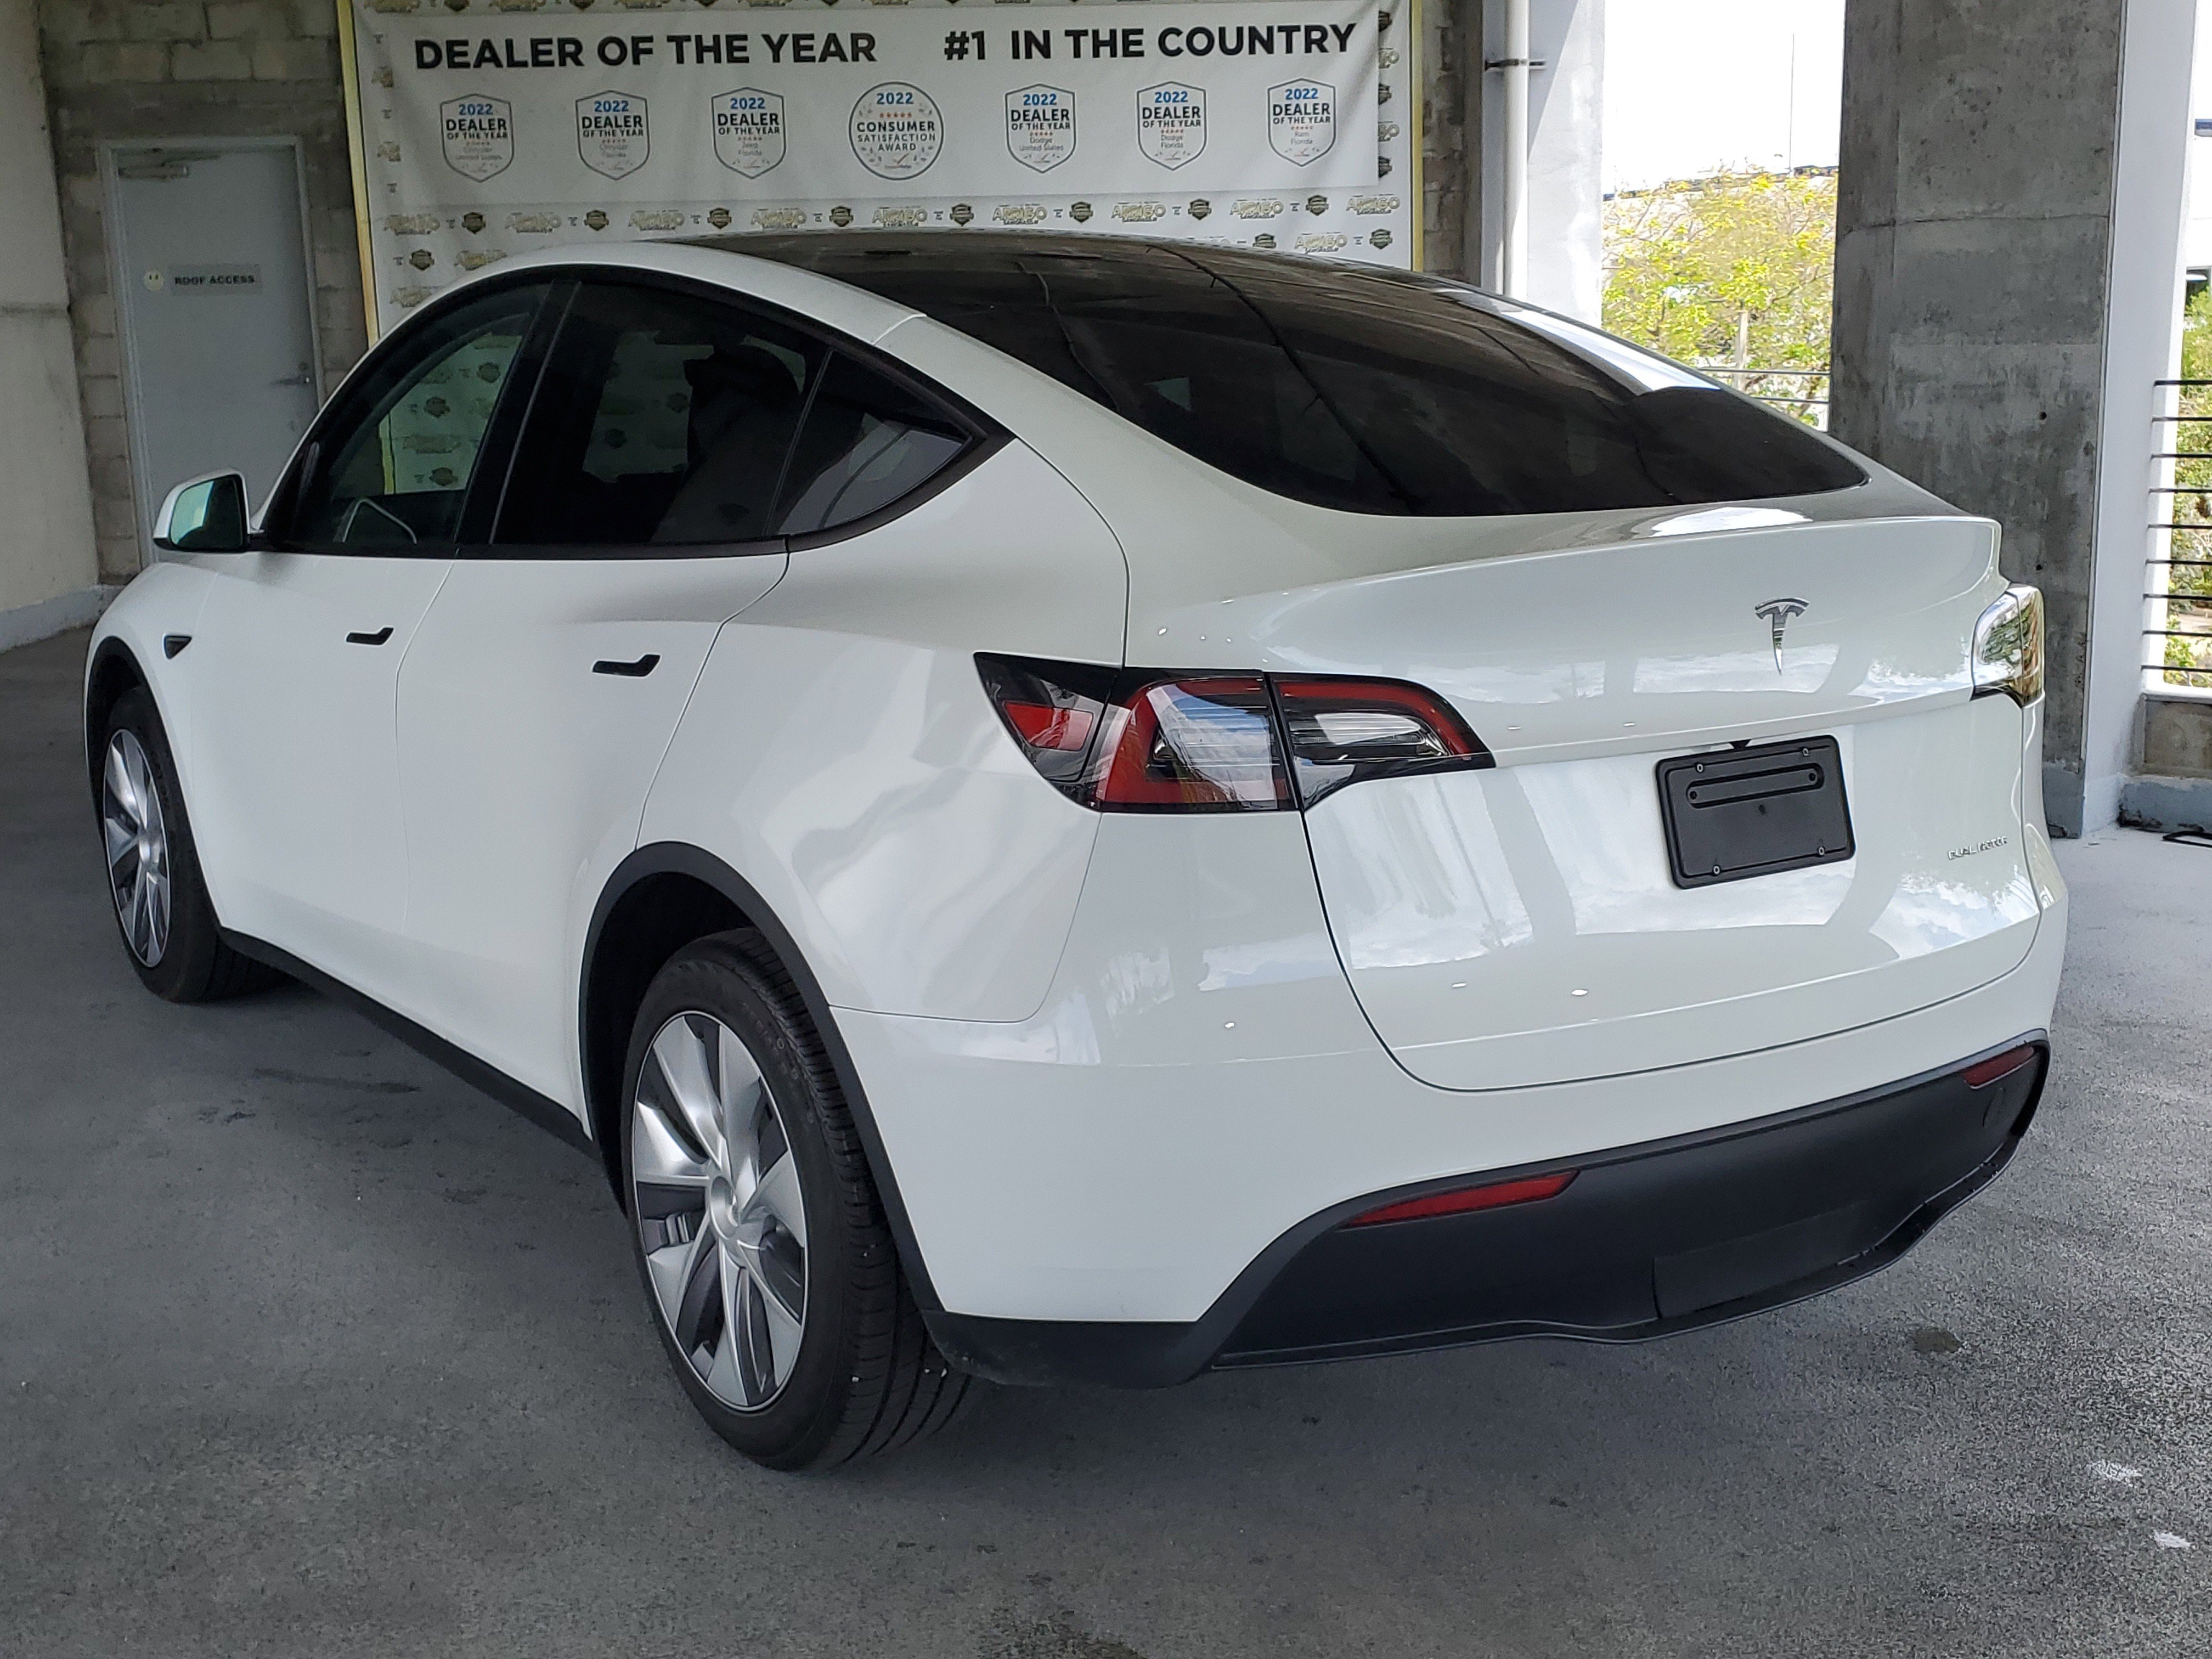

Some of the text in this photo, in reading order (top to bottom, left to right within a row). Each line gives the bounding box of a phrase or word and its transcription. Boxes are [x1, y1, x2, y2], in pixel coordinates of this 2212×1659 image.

[944, 22, 1357, 61] #1 IN THE COUNTRY
[415, 33, 877, 69] DEALER OF THE YEAR
[877, 92, 914, 105] 2022
[1023, 93, 1057, 106] 2022
[1154, 91, 1188, 103] 2022
[1285, 88, 1319, 100] 2022
[459, 103, 493, 116] 2022
[594, 100, 629, 112] 2022
[730, 97, 765, 110] 2022
[1273, 103, 1330, 116] DEALER
[718, 113, 780, 126] DEALER
[1011, 108, 1070, 122] DEALER
[1142, 106, 1201, 120] DEALER
[446, 118, 507, 131] DEALER
[582, 115, 643, 129] DEALER
[857, 121, 935, 133] CONSUMER
[1011, 122, 1024, 131] OF
[1047, 122, 1070, 130] YEAR
[1158, 120, 1175, 128] THE
[1178, 119, 1201, 127] YEAR
[857, 133, 936, 143] SATISFACTION
[878, 143, 917, 152] AWARD
[175, 275, 255, 285] ROOF ACCESS
